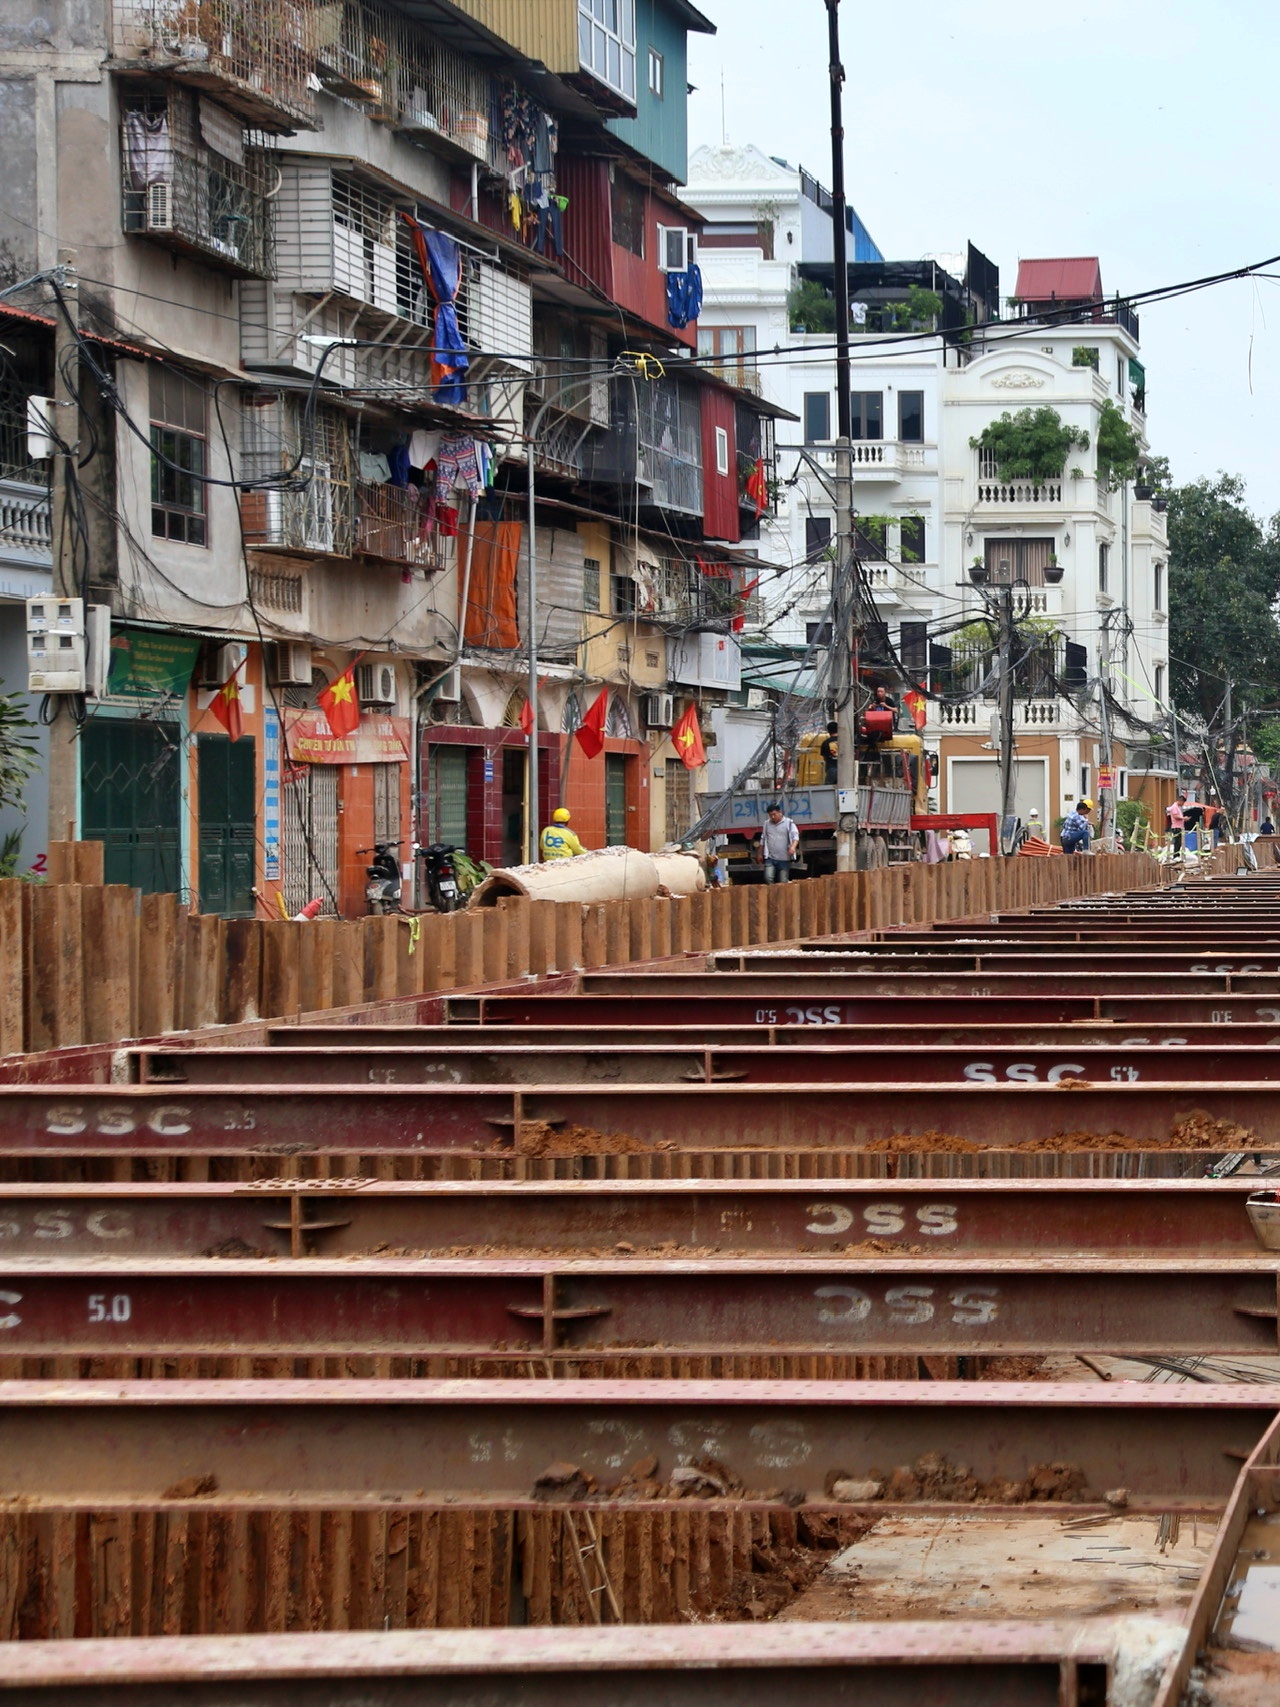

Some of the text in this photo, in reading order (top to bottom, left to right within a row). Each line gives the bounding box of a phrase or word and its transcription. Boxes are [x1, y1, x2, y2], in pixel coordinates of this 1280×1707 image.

[545, 831, 565, 848] be
[31, 853, 48, 872] 2
[785, 1006, 842, 1025] SSC
[963, 1063, 1086, 1084] SSC
[45, 1104, 192, 1136] SSC
[805, 1203, 959, 1236] SSC
[88, 1294, 131, 1322] 5.0
[813, 1285, 999, 1326] SSC
